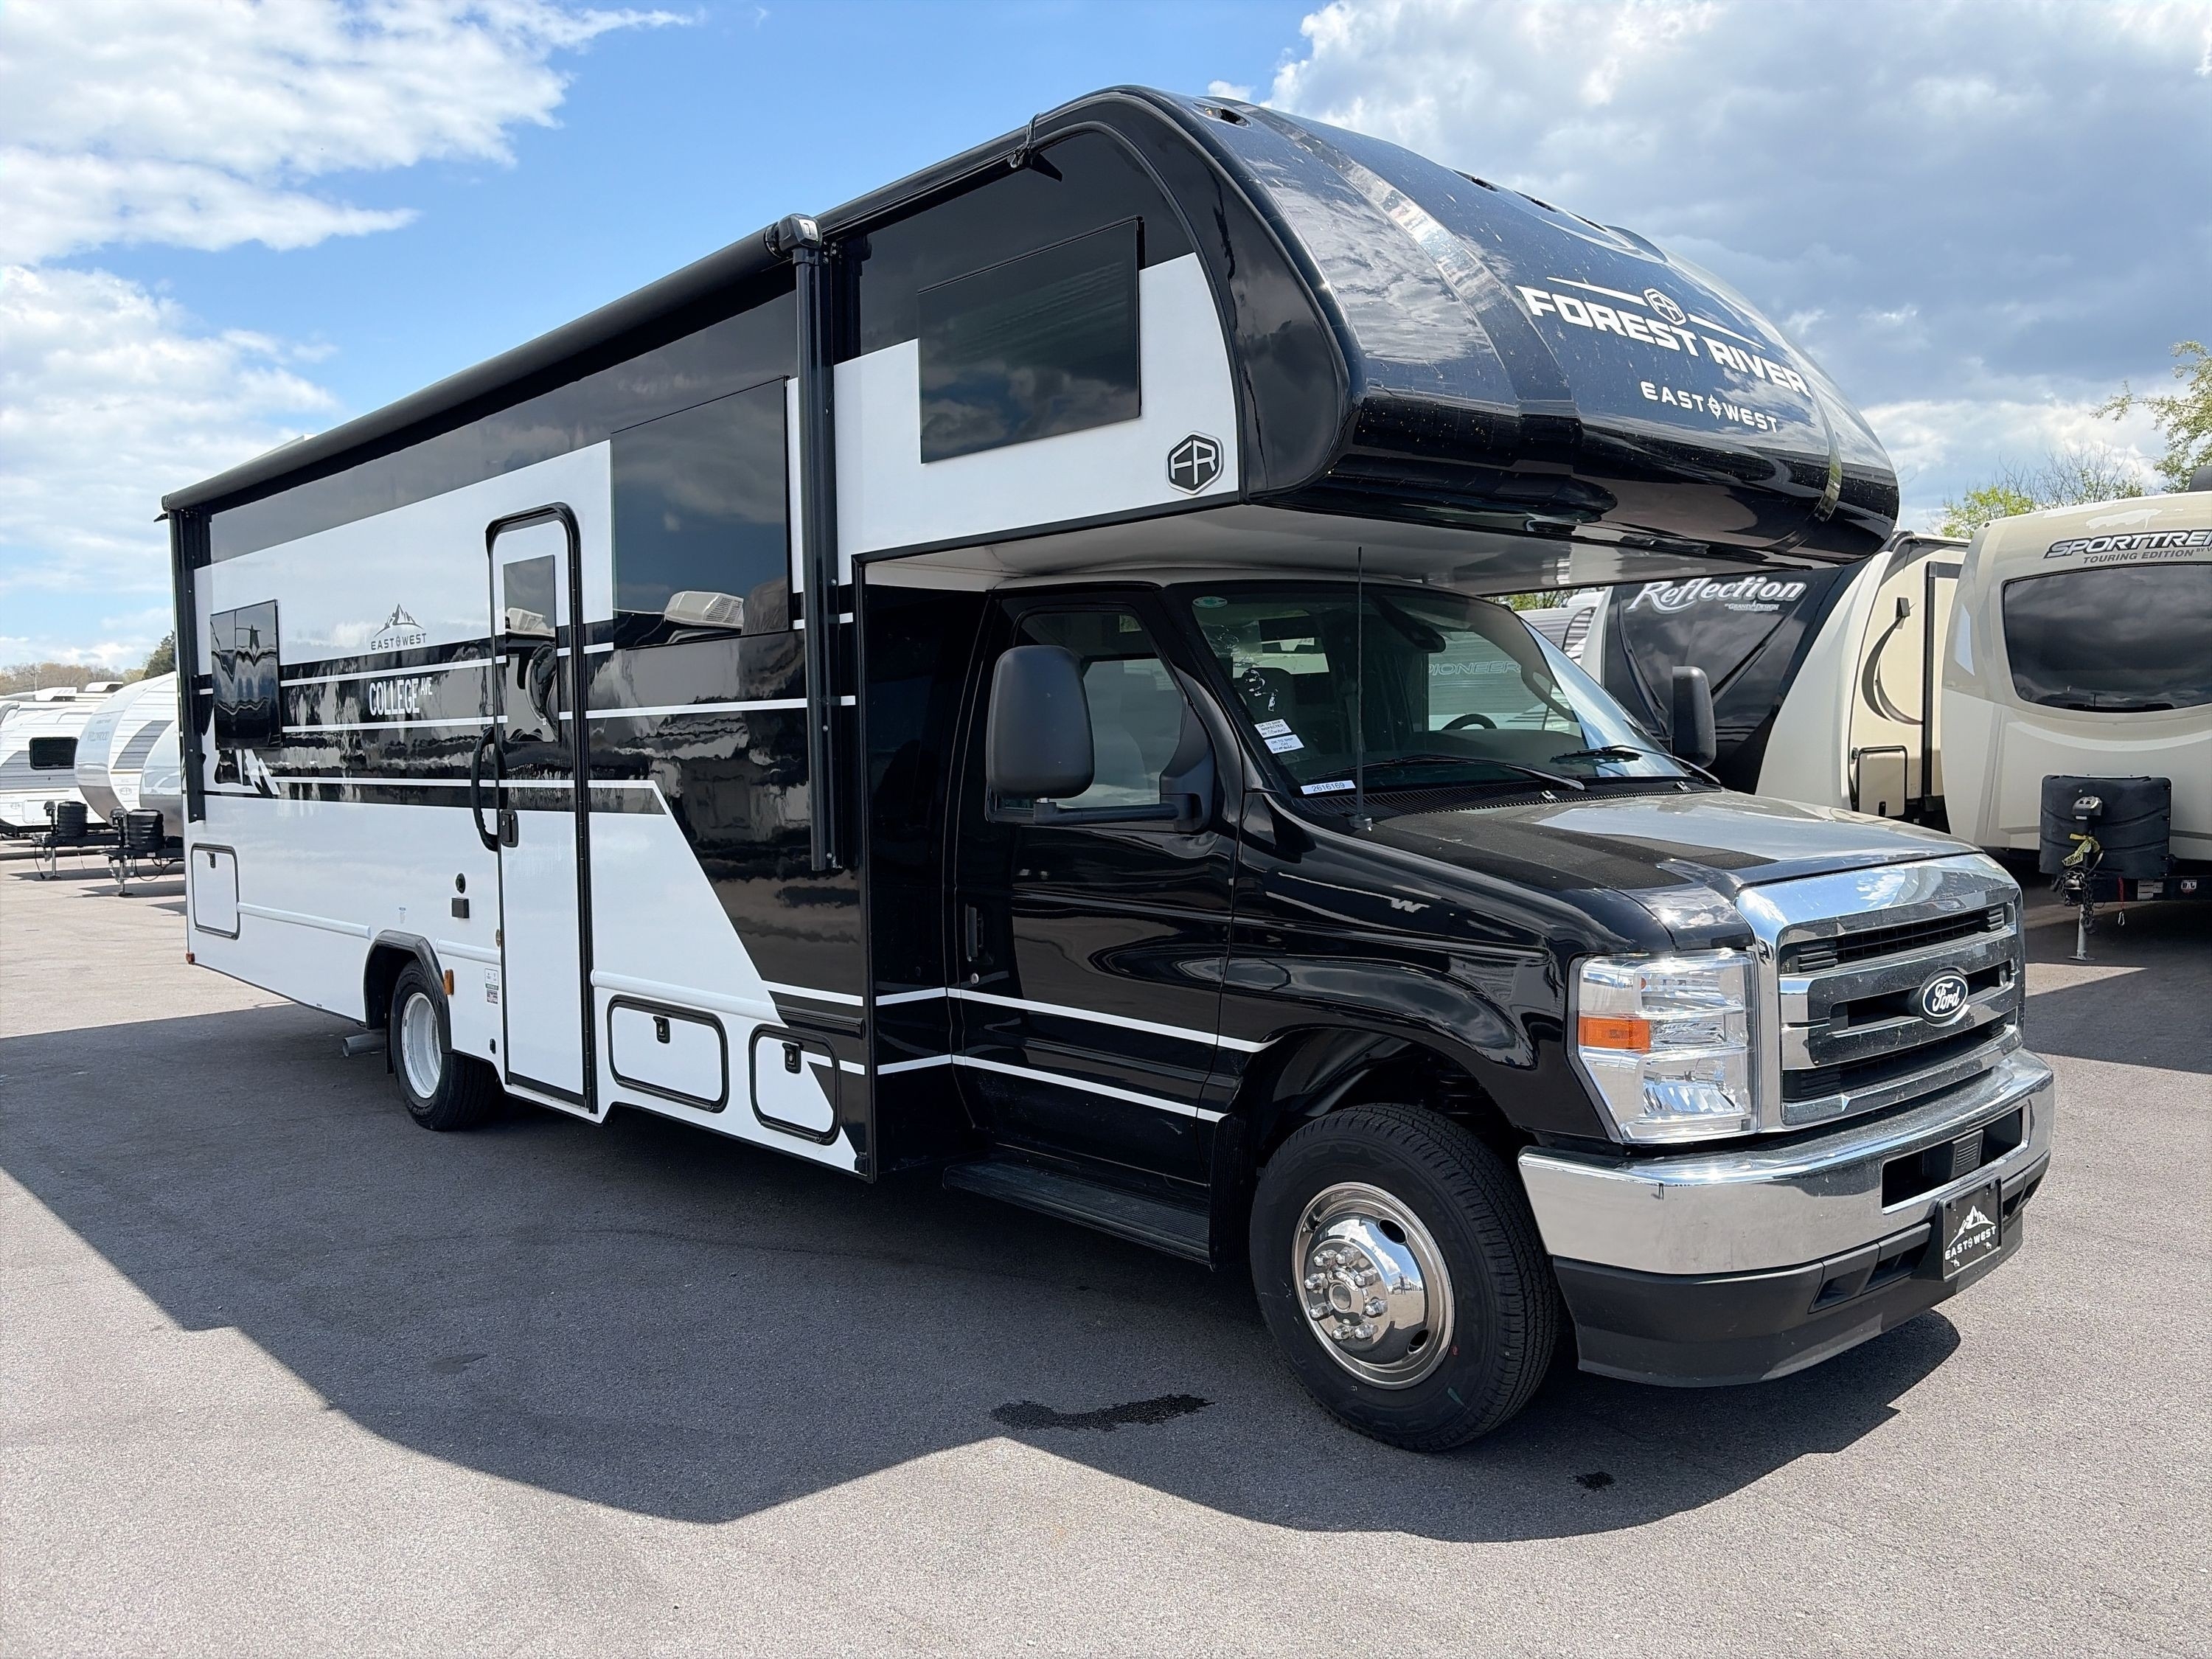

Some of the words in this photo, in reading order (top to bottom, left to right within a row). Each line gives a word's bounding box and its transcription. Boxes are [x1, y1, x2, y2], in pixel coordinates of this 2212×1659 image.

[1514, 285, 1700, 357] FOREST
[1701, 335, 1813, 399] RIVER
[1640, 380, 1705, 413] EAST
[1722, 403, 1778, 434] WEST
[1170, 439, 1216, 485] FR
[2083, 552, 2138, 564] TOURING
[2141, 549, 2194, 560] EDITION
[1625, 576, 1806, 612] Reflection
[371, 638, 394, 650] EAST
[402, 633, 427, 646] WEST
[369, 678, 420, 716] COLLEGE
[420, 676, 433, 695] AVE
[1311, 782, 1346, 792] 2616169
[1932, 981, 1961, 1012] Ford
[1944, 1239, 1968, 1261] EAST
[1973, 1225, 1997, 1245] WEST
